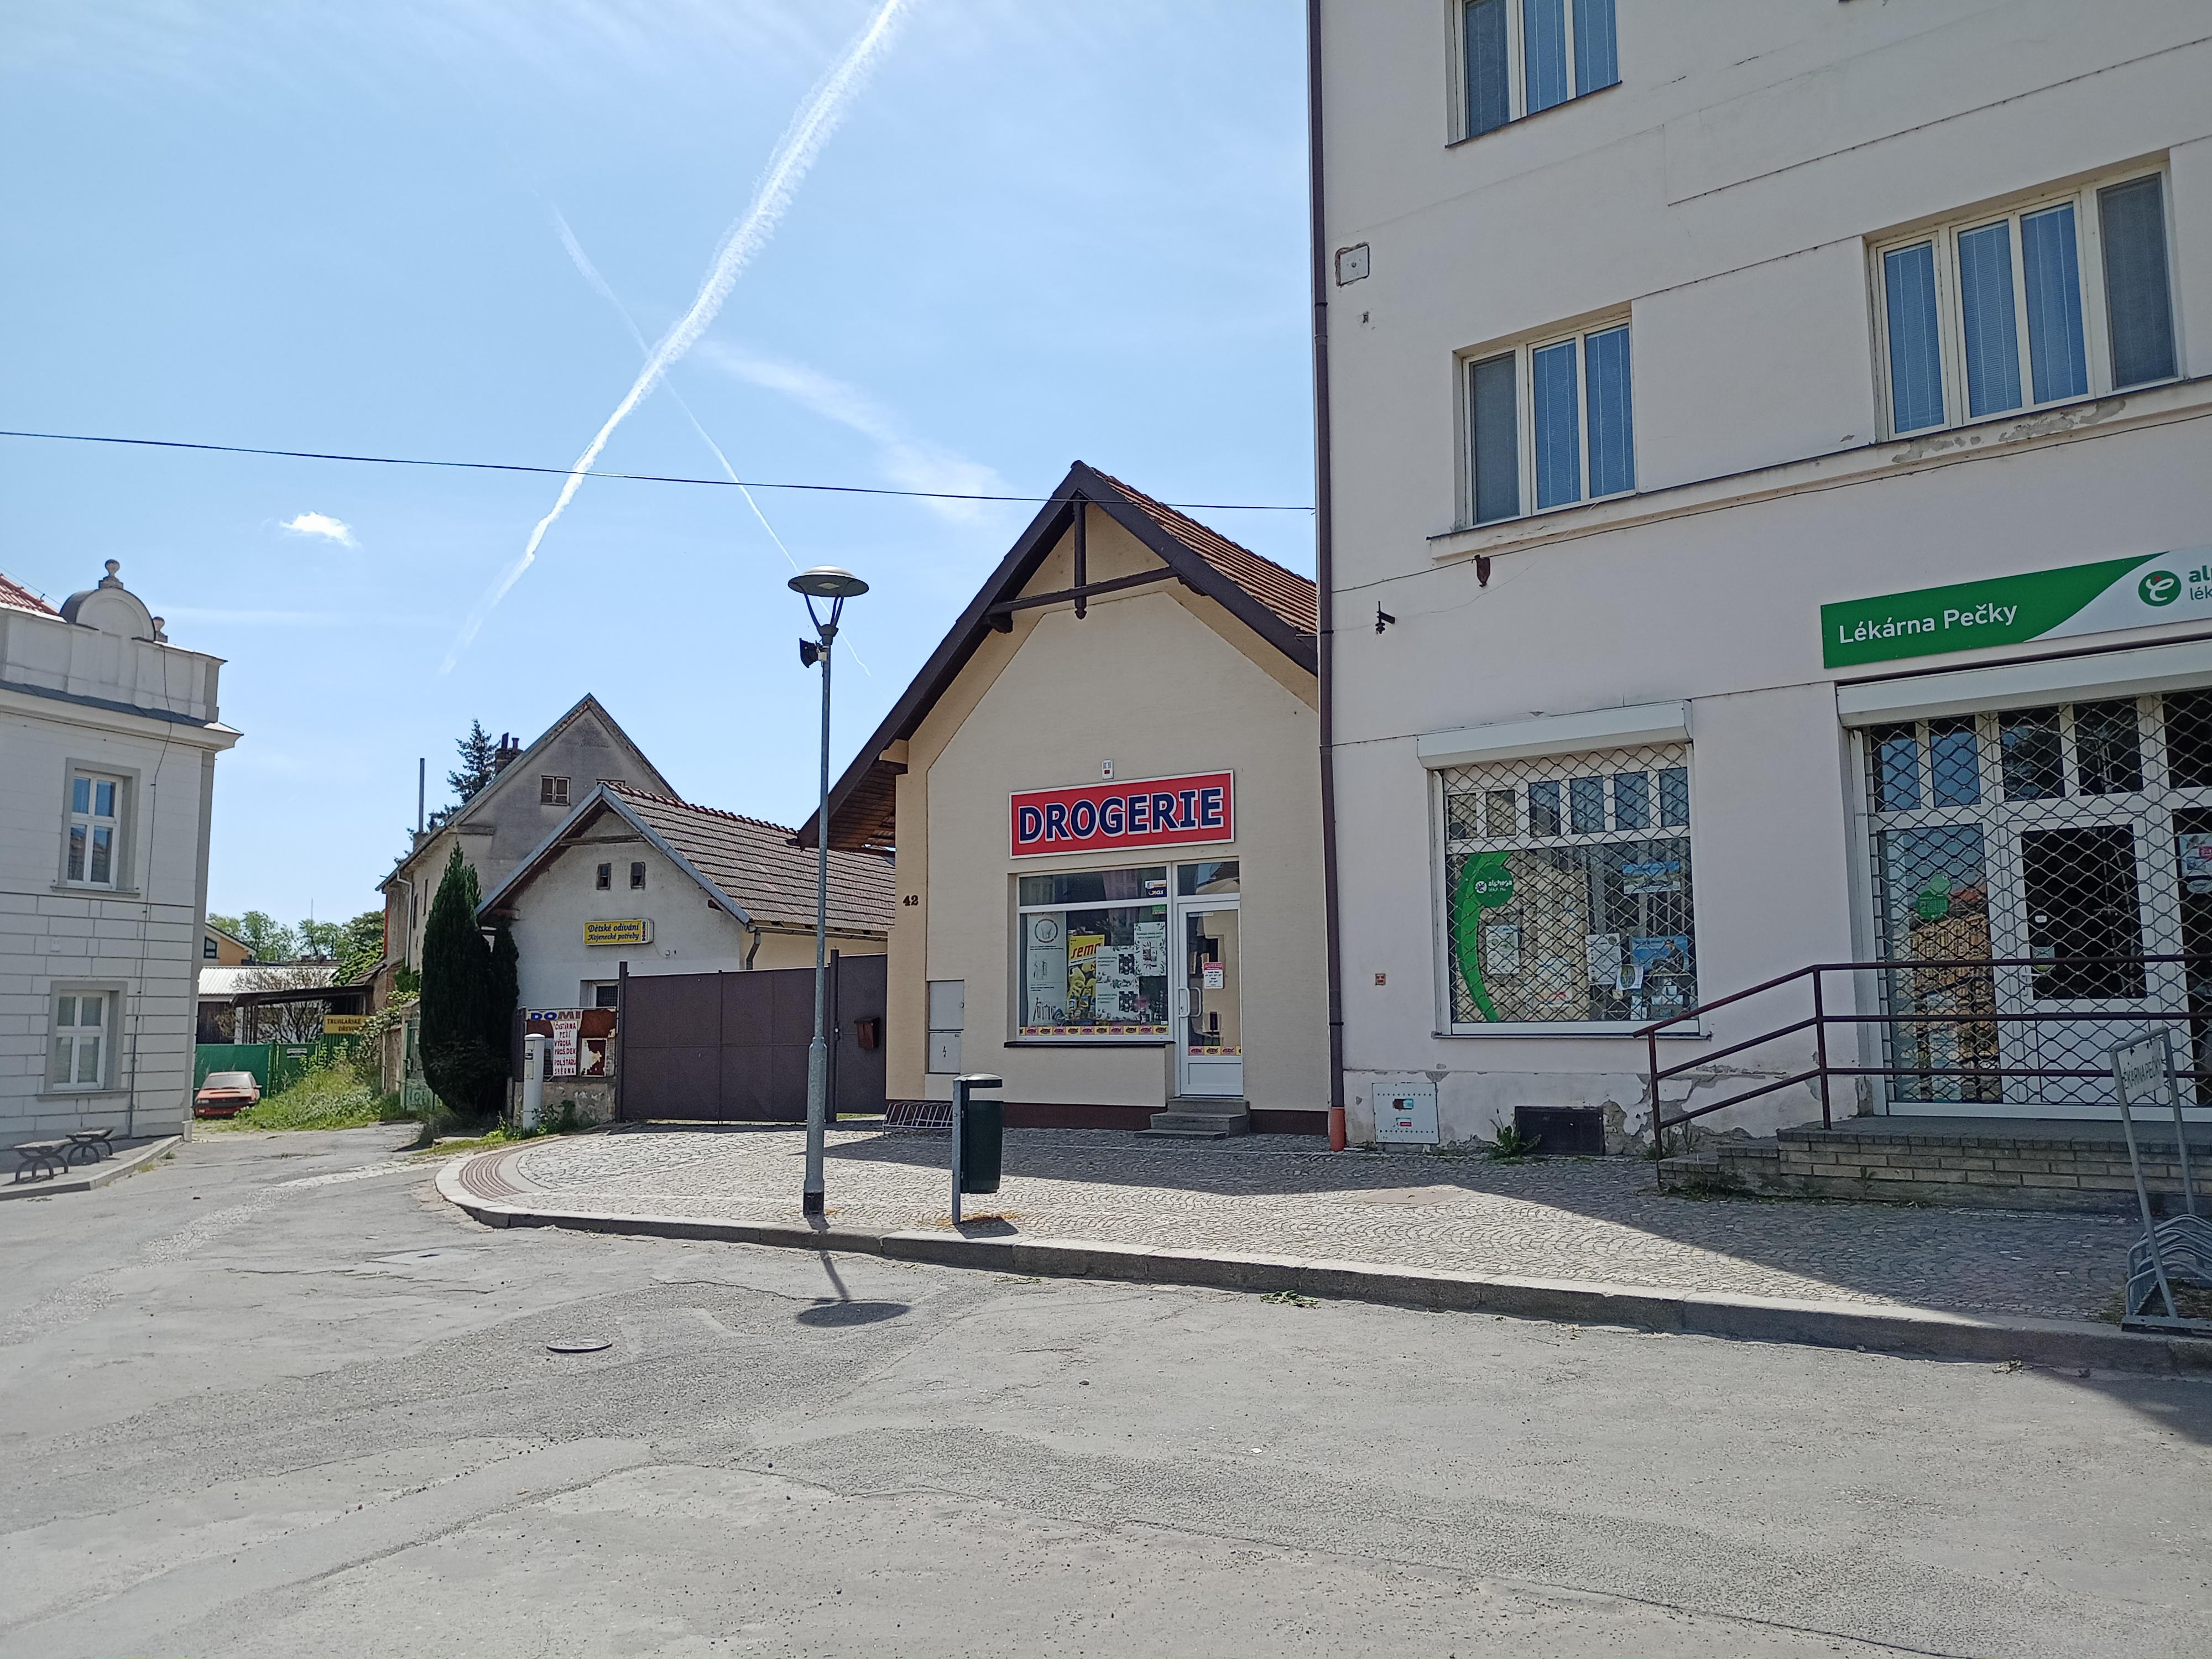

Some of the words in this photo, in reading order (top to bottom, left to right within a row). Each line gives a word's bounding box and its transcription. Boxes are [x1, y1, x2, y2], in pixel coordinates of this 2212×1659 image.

[2188, 565, 2212, 584] al
[1839, 617, 1936, 644] Lékárna
[1943, 602, 2018, 629] Pečky
[1018, 786, 1224, 844] DROGERIE
[902, 895, 919, 906] 42
[588, 924, 612, 932] Dětské
[613, 922, 640, 932] odívání
[617, 932, 639, 941] potřeby
